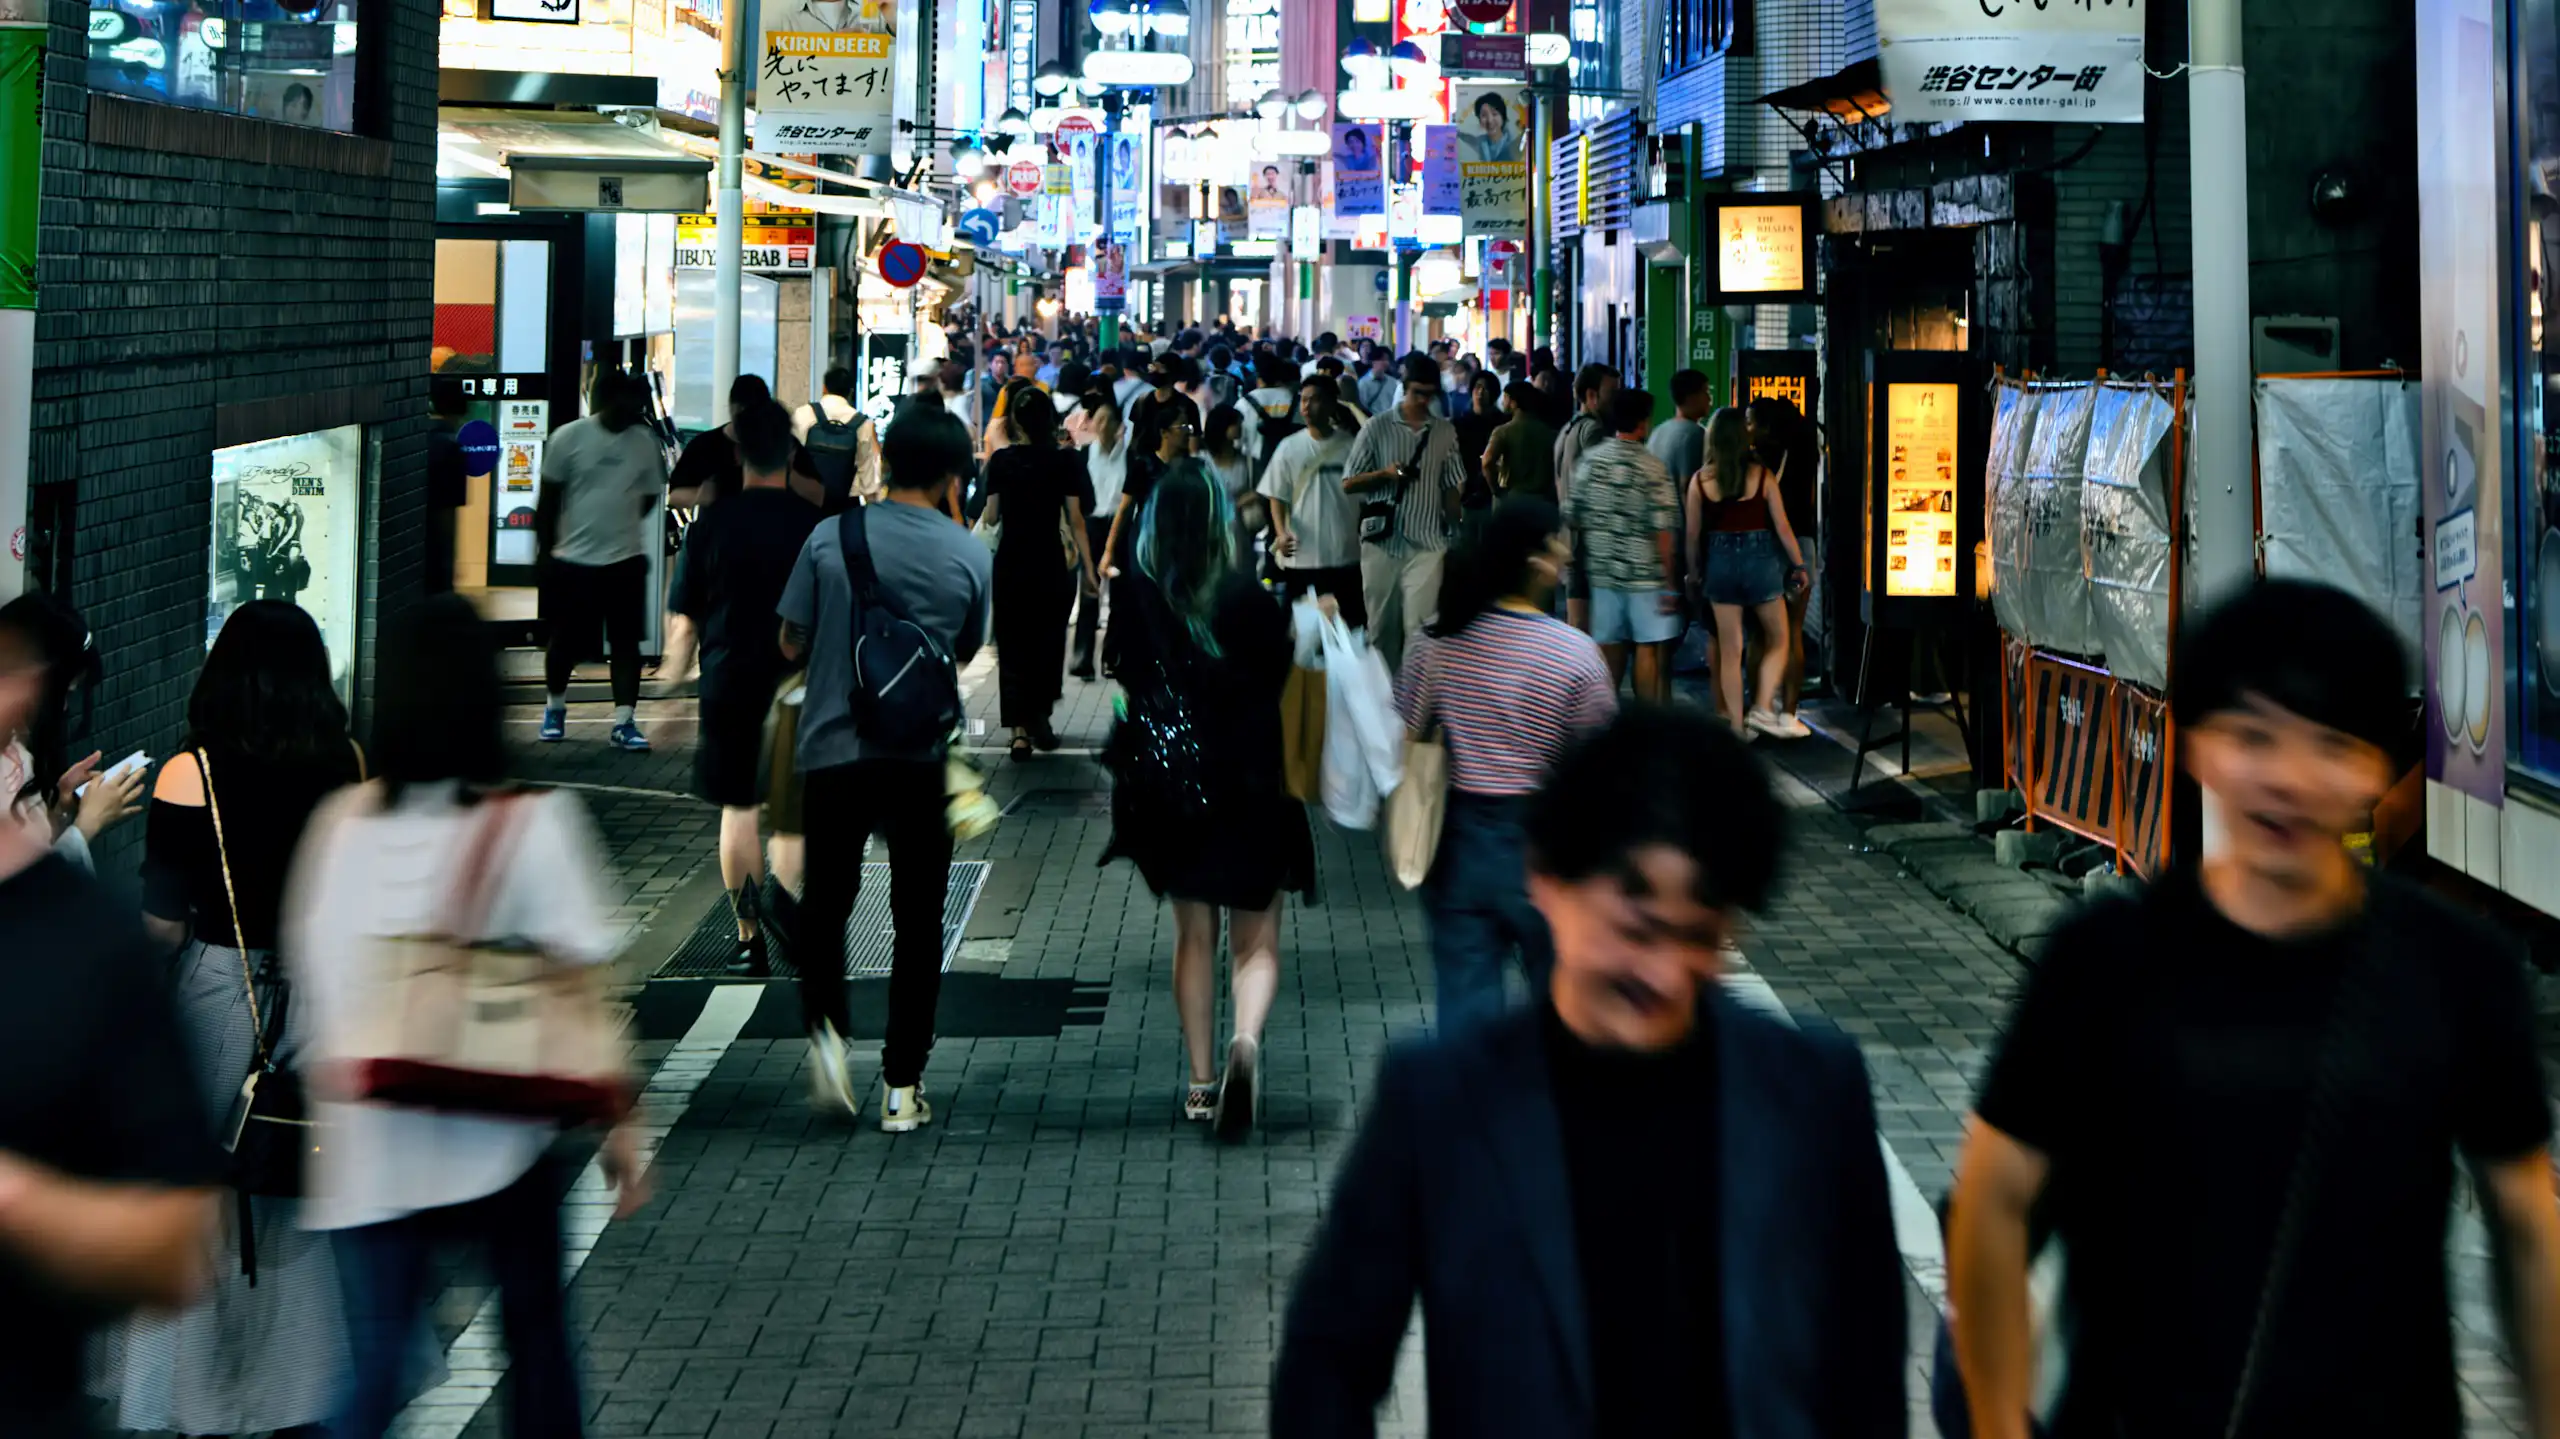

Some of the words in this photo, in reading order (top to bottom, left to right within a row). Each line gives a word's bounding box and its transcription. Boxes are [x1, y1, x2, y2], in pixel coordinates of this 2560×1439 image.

[775, 36, 830, 52] KIRIN
[834, 37, 881, 54] BEER
[764, 45, 818, 80] 先に
[776, 66, 889, 103] やってます!
[1919, 64, 2108, 92] 渋谷センター街
[775, 125, 873, 140] 渋谷センター街
[291, 486, 325, 496] DENIM
[292, 477, 323, 487] MEN'S
